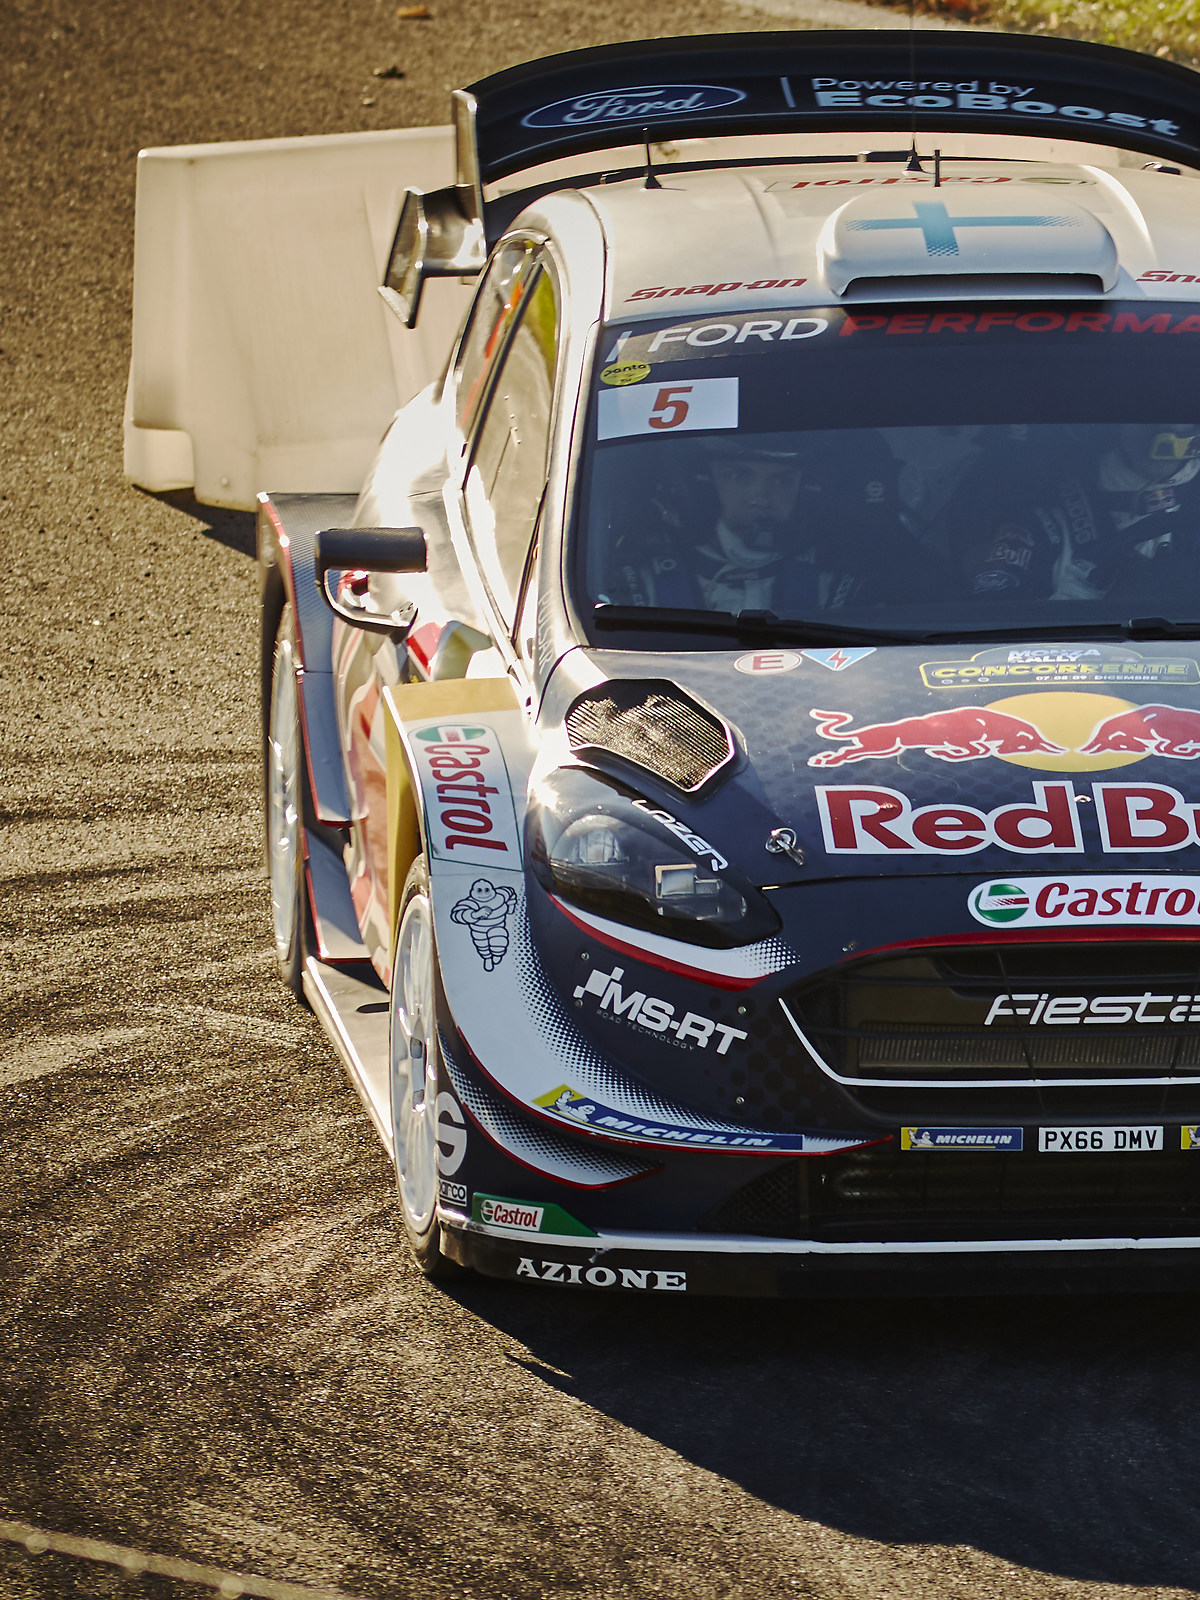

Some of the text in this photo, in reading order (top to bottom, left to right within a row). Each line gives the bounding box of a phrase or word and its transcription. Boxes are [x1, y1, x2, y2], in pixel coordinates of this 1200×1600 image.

[812, 77, 1035, 99] Powered by
[562, 89, 706, 123] Ford
[814, 91, 1181, 137] EcoBoost
[624, 278, 807, 302] Snap-on
[647, 317, 829, 353] FORD
[647, 385, 694, 430] 5
[752, 654, 785, 671] E
[931, 664, 1188, 679] CONCORRENTE
[423, 744, 508, 852] Castrol
[824, 786, 1078, 850] Red
[596, 1009, 695, 1051] ROAD TECHNOLOGY
[599, 1114, 773, 1148] MICHELIN
[935, 1133, 1012, 1146] MICHELIN
[1044, 1129, 1159, 1150] PX66 DMV
[440, 1181, 467, 1200] arco
[494, 1203, 539, 1228] Castrol
[516, 1257, 687, 1292] AZIONE
